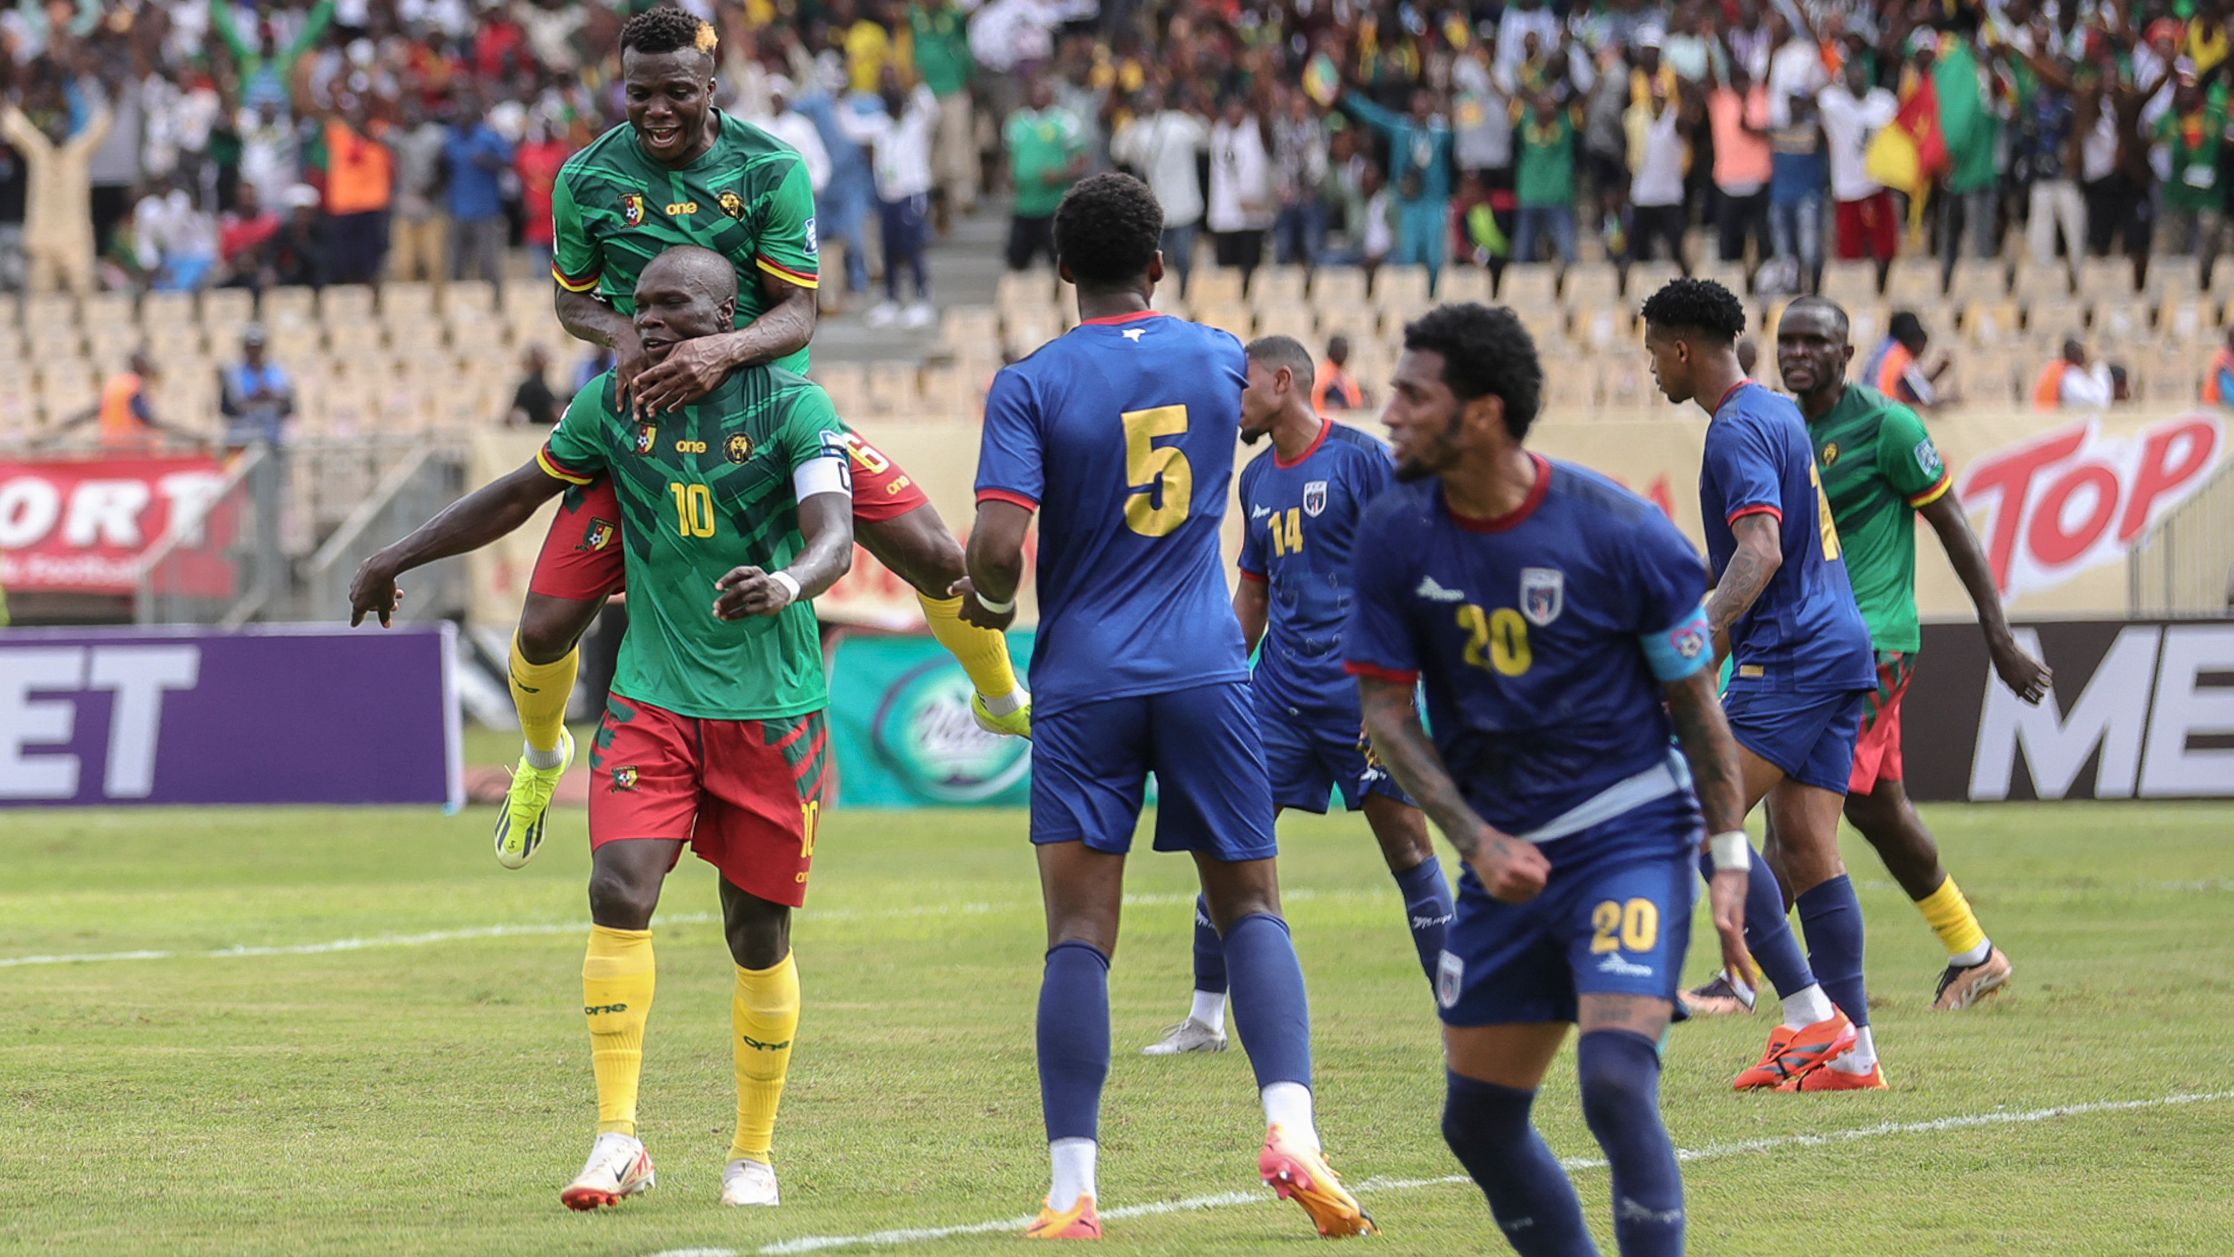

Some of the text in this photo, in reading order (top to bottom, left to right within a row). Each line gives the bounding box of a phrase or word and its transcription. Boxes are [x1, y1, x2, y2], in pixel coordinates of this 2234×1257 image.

[665, 202, 698, 216] one
[675, 438, 707, 454] one
[1121, 404, 1193, 538] 5
[671, 482, 717, 539] 10
[1267, 507, 1304, 558] 14
[1961, 420, 2218, 598] TOP
[1455, 604, 1533, 678] 20
[0, 644, 201, 800] ET
[1967, 622, 2234, 801] ME
[1590, 897, 1659, 955] 20
[584, 1003, 628, 1016] one
[743, 1035, 790, 1051] one
